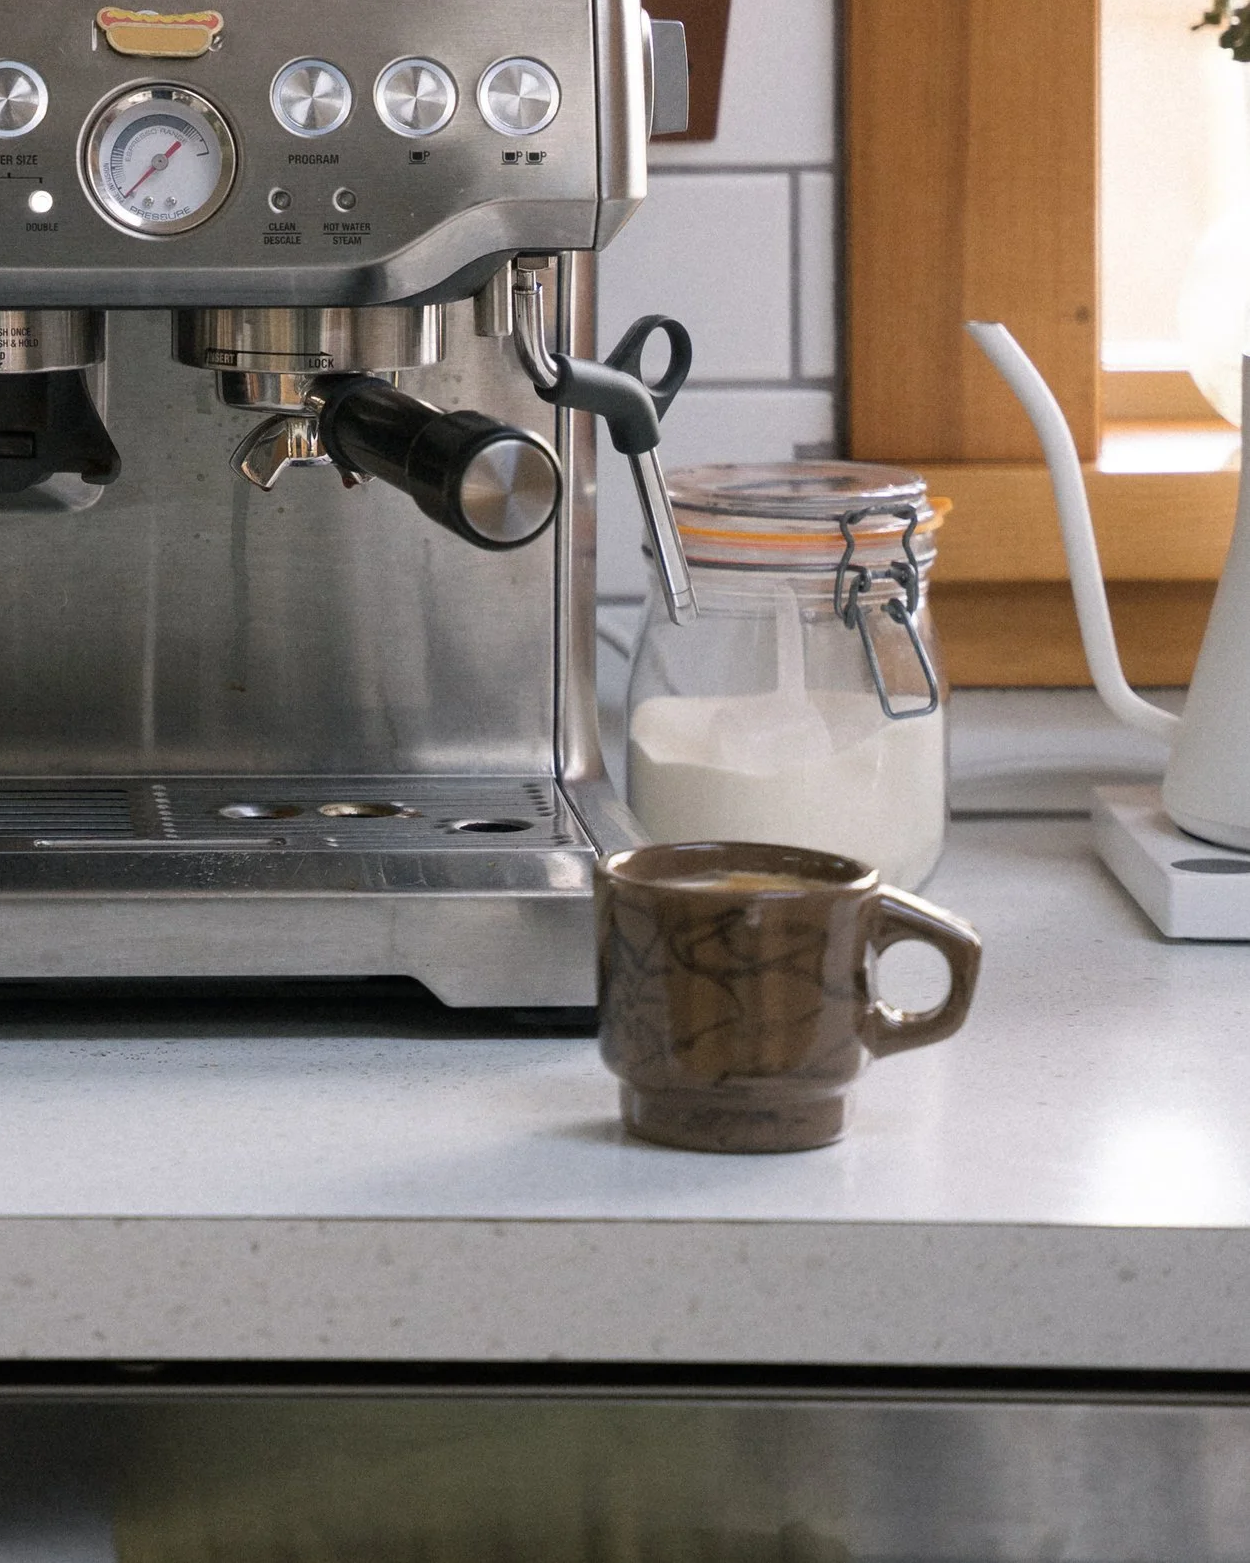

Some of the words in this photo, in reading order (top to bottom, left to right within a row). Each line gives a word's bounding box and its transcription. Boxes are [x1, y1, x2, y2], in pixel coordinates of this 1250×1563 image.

[16, 154, 38, 166] SIZE
[288, 154, 339, 165] PROGRAM
[130, 205, 191, 221] PRESSURE
[26, 223, 59, 232] DOUBLE
[268, 222, 296, 232] CLEAN
[323, 222, 340, 232] HOT
[342, 222, 371, 232] WATER
[264, 236, 301, 245] DESCALE
[332, 236, 362, 245] STEAM
[10, 327, 31, 337] ONCE
[10, 339, 17, 348] &
[18, 339, 39, 348] HOLD
[309, 358, 335, 369] LOCK
